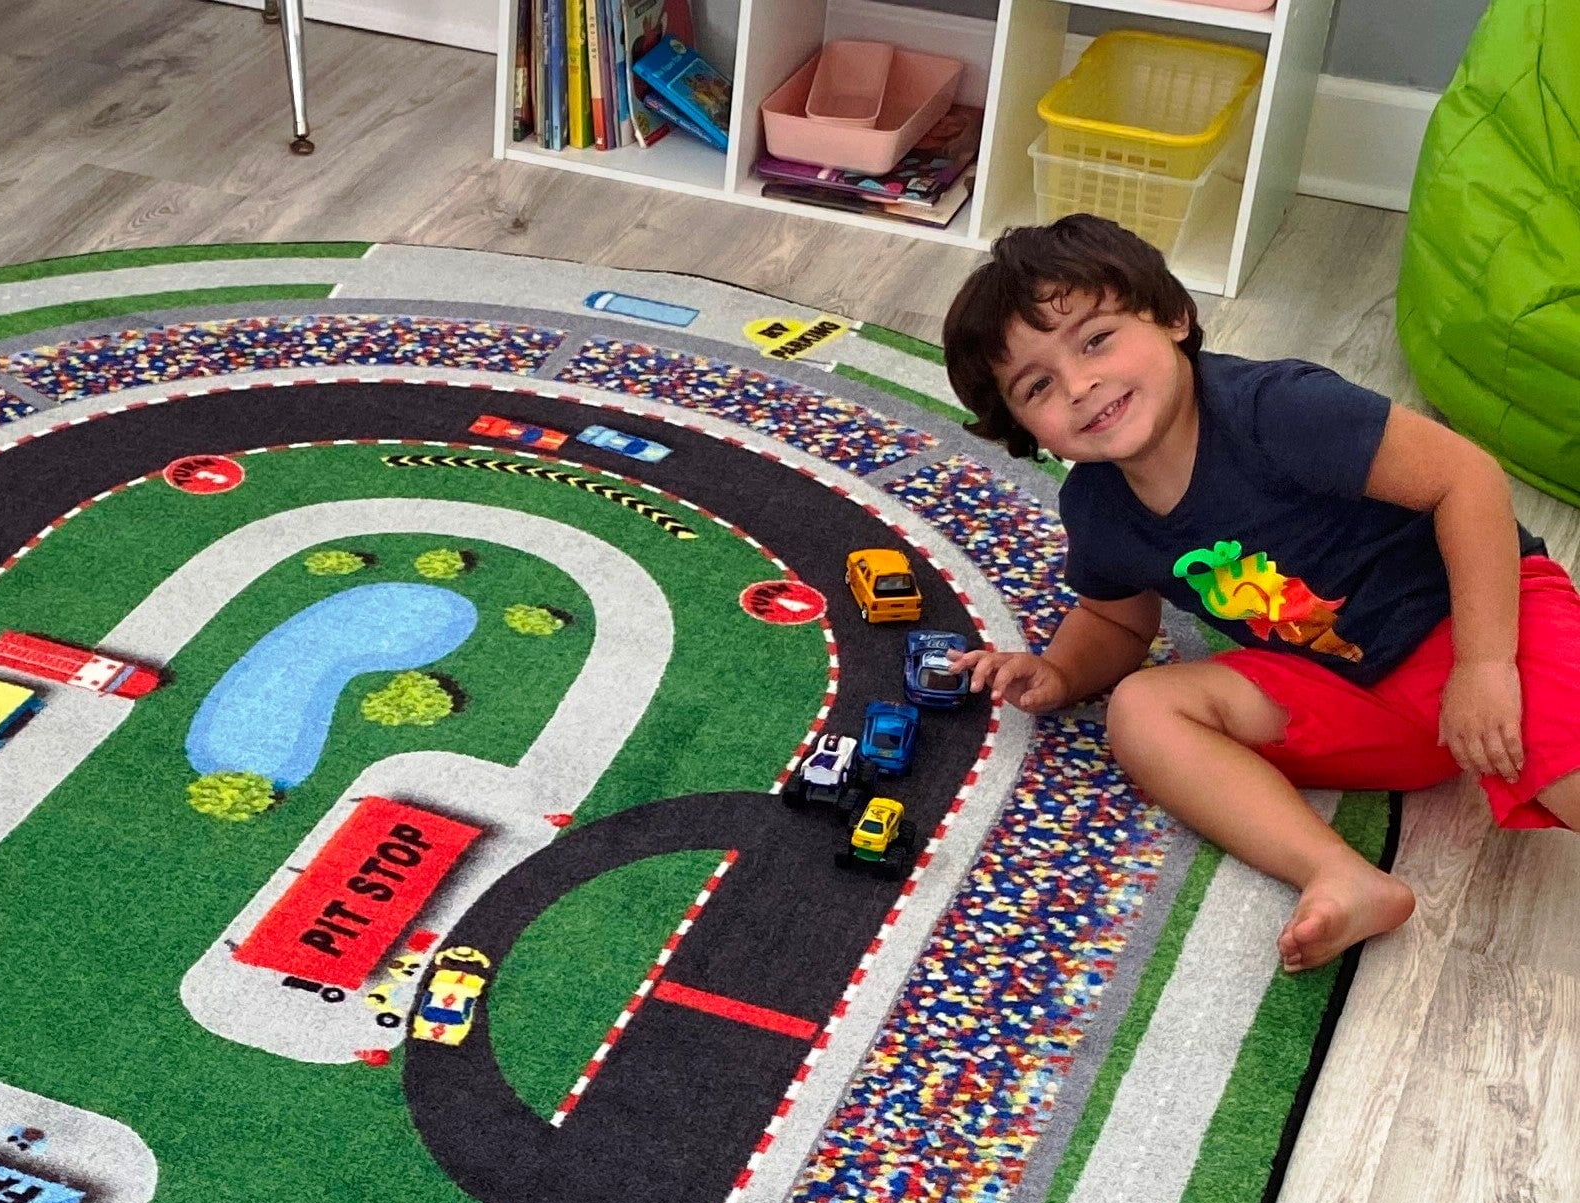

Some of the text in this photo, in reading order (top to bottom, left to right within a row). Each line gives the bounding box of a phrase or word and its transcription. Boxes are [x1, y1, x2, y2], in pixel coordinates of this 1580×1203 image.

[770, 321, 841, 360] PARKING
[173, 458, 216, 486] TURN
[751, 584, 792, 616] TURN
[299, 824, 433, 959] PIT STOP
